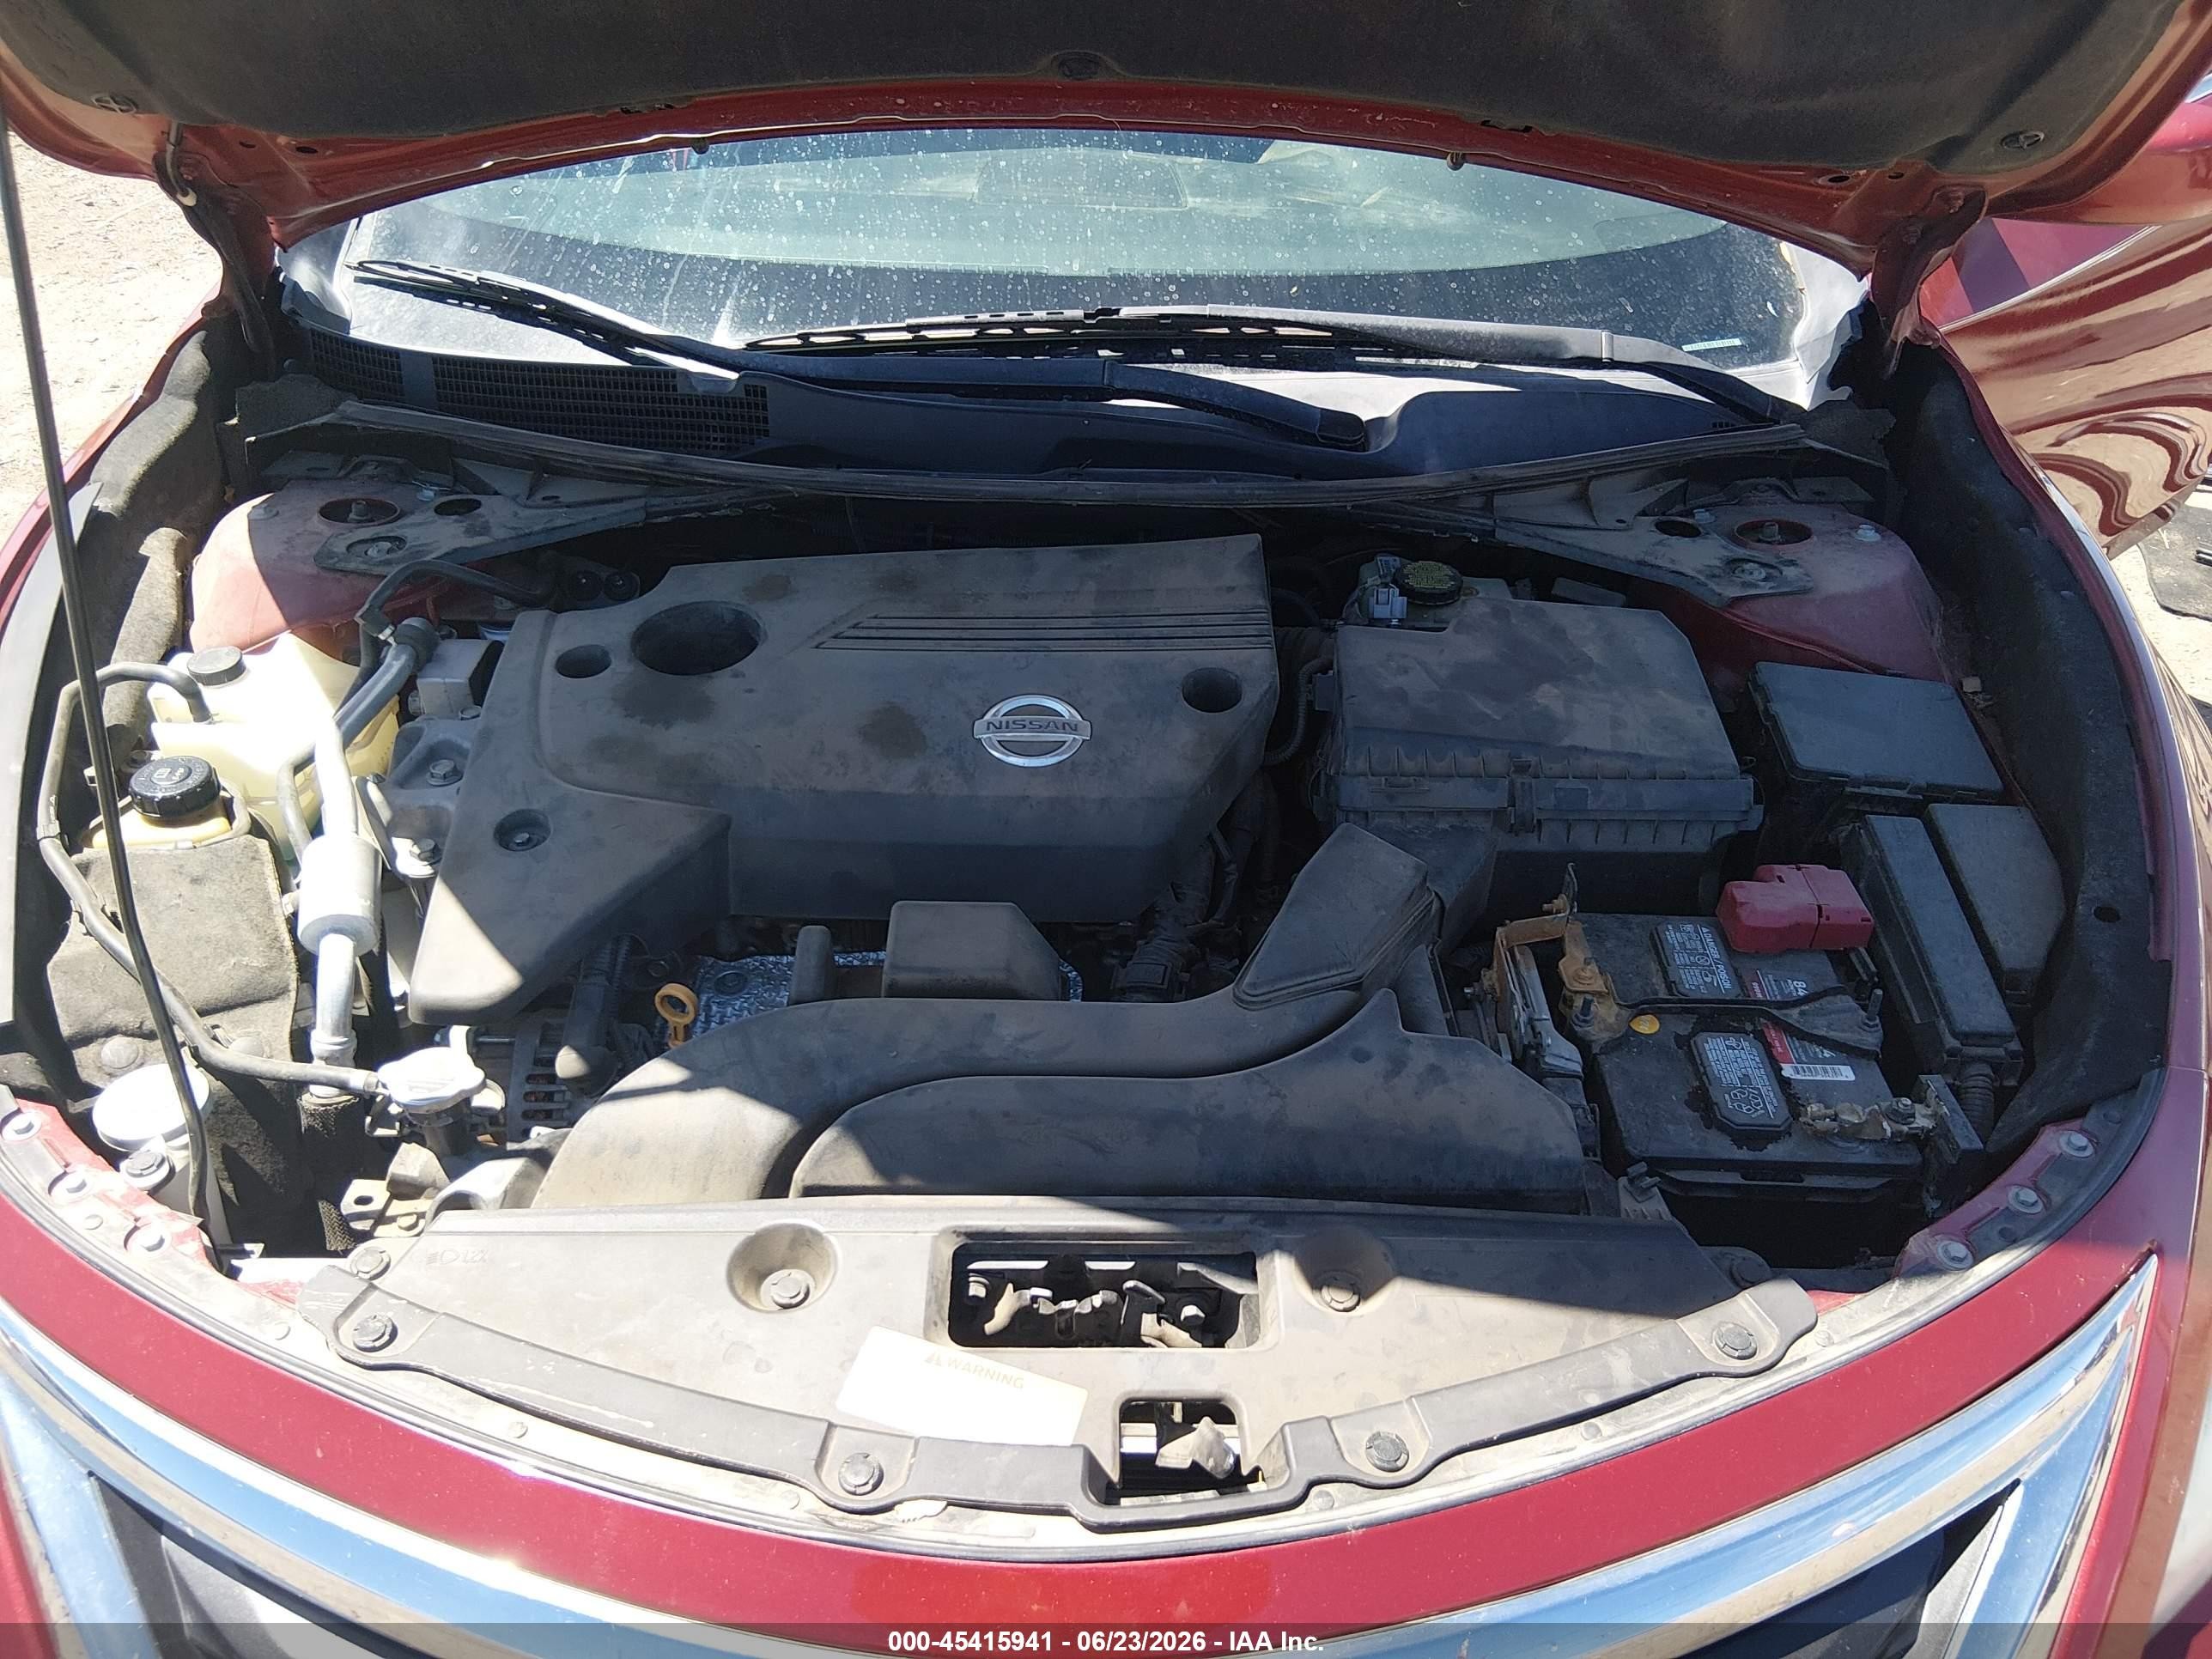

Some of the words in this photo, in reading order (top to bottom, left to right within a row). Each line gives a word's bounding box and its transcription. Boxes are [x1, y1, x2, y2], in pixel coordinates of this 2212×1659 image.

[986, 720, 1079, 732] NISSAN
[1704, 933, 1720, 958] DANGER
[1716, 963, 1732, 989] POISON
[947, 1358, 1024, 1389] WARNING
